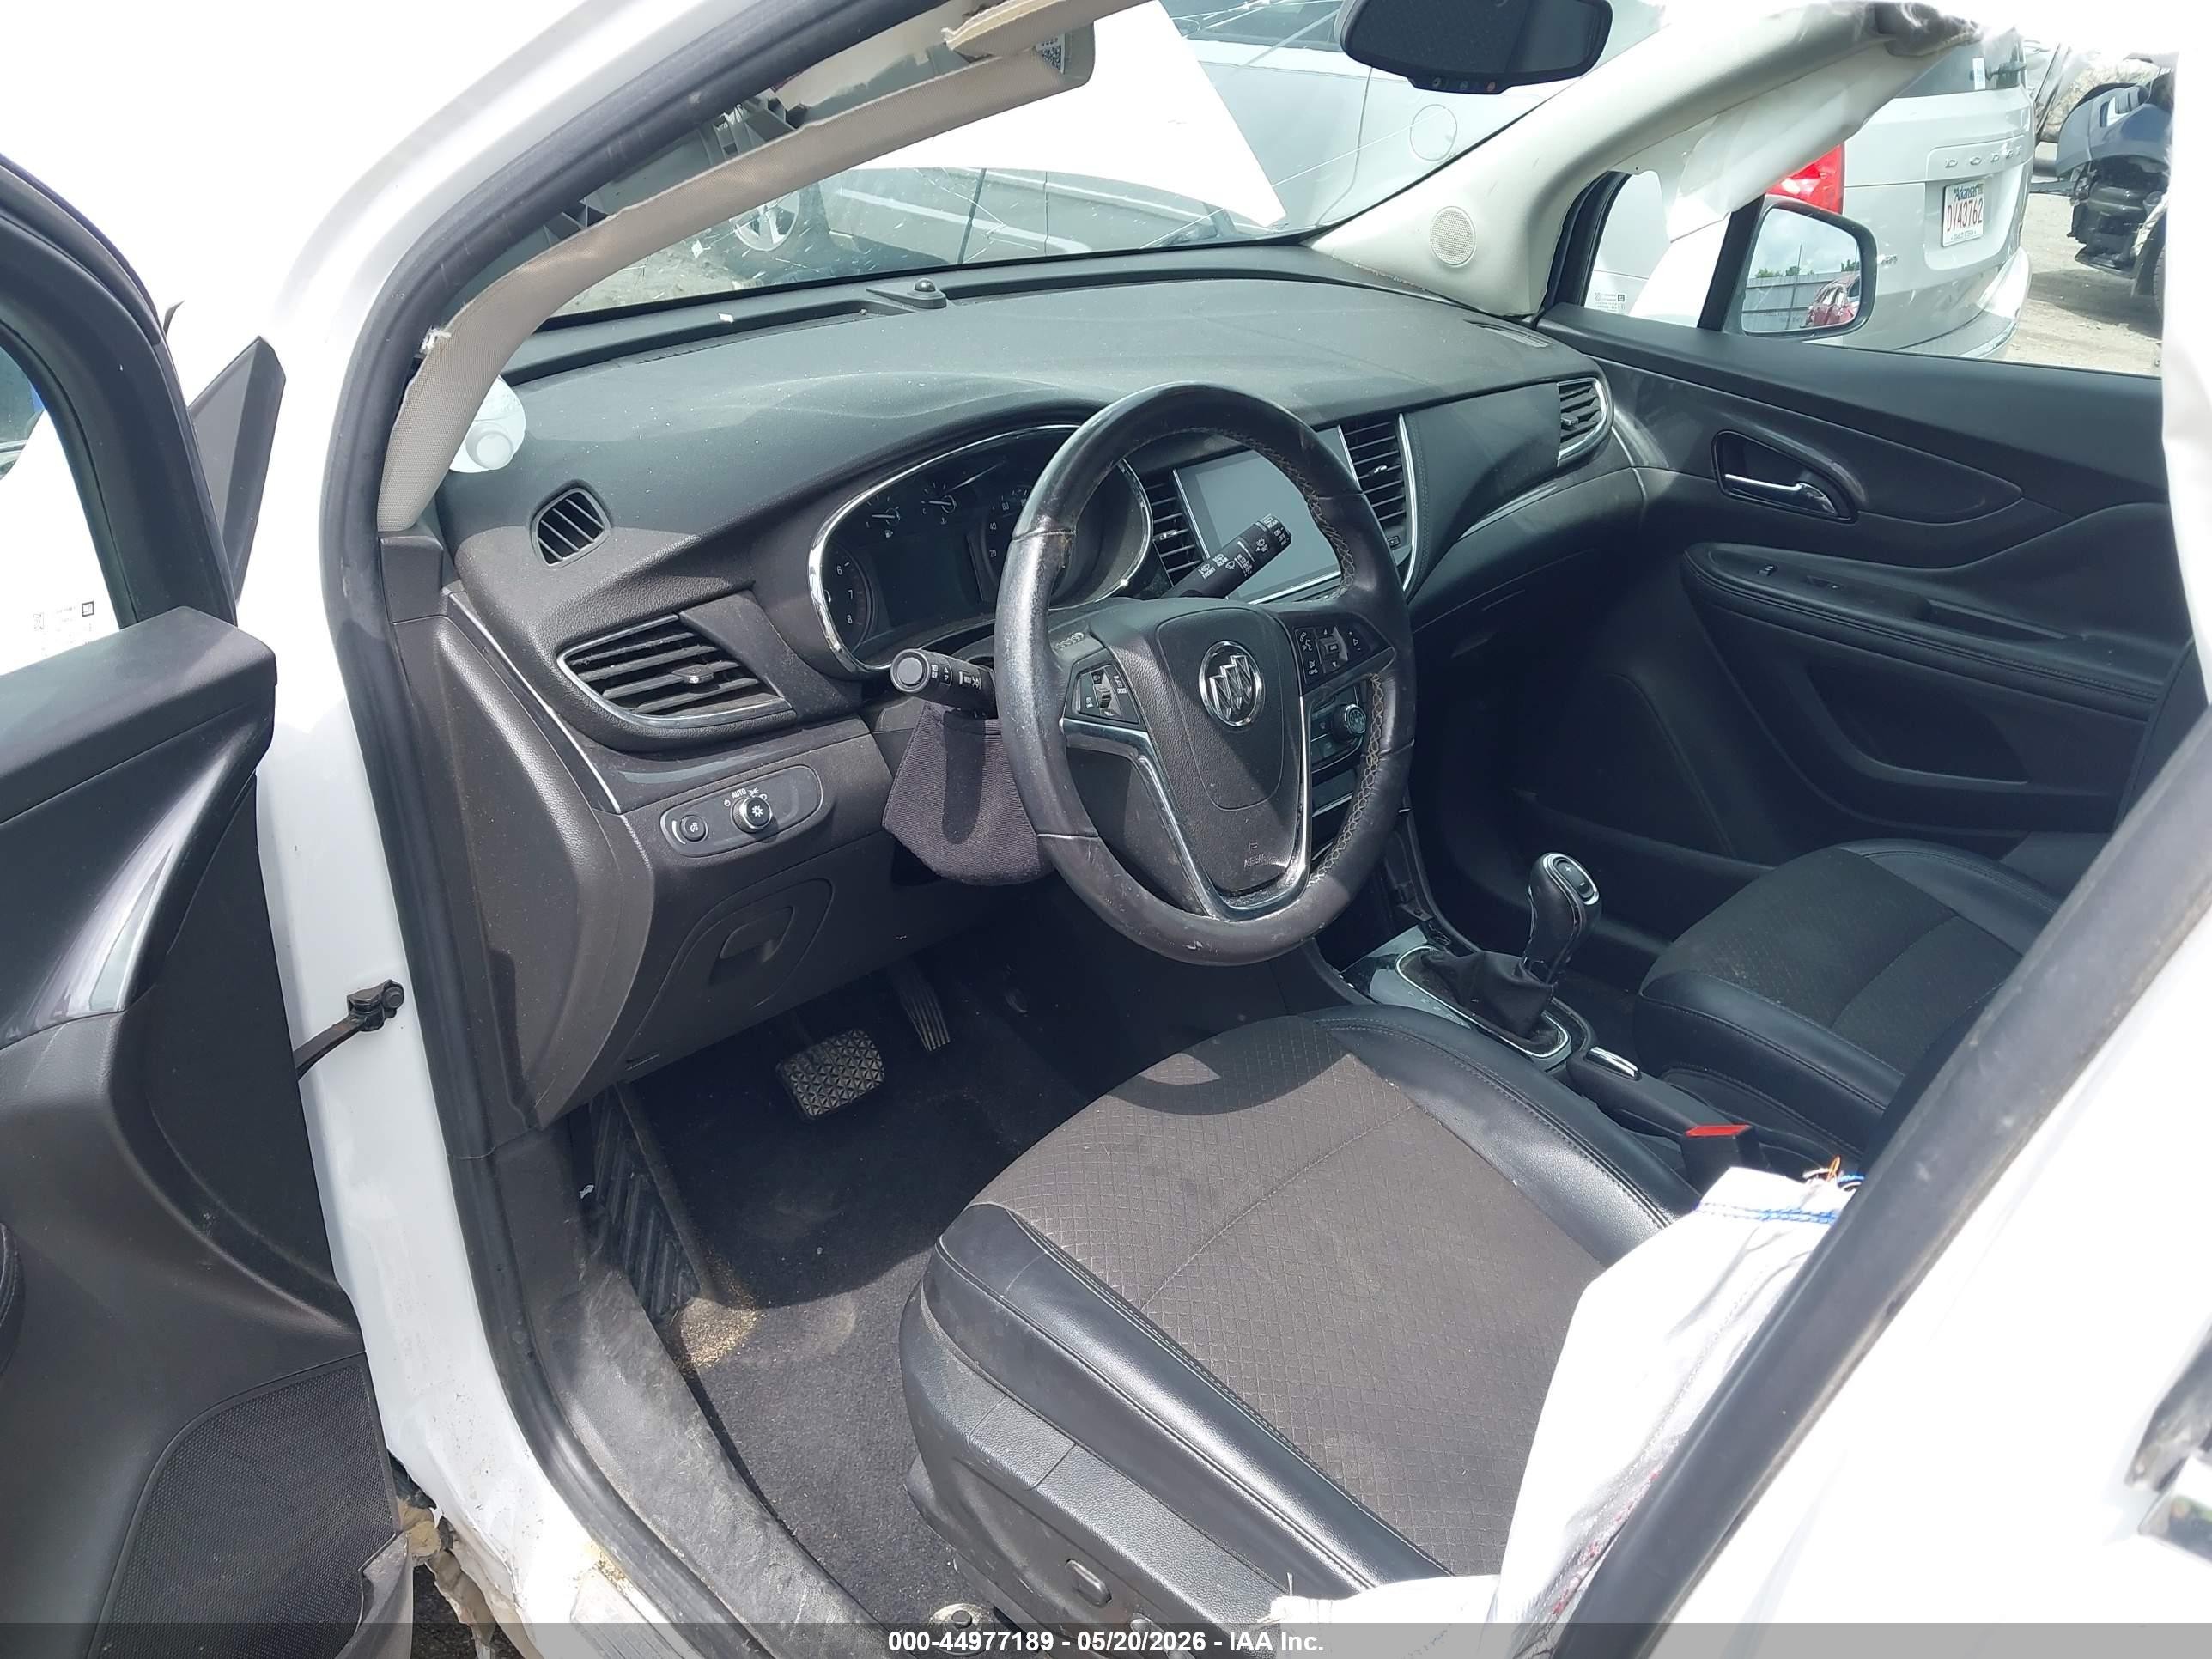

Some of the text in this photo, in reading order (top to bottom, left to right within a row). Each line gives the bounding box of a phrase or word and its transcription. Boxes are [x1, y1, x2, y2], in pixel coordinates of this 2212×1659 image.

[1947, 198, 1984, 232] DV43762
[989, 549, 997, 557] 20
[836, 566, 842, 575] 6
[848, 590, 853, 600] 7
[847, 615, 853, 623] 8
[732, 788, 746, 799] AUTO
